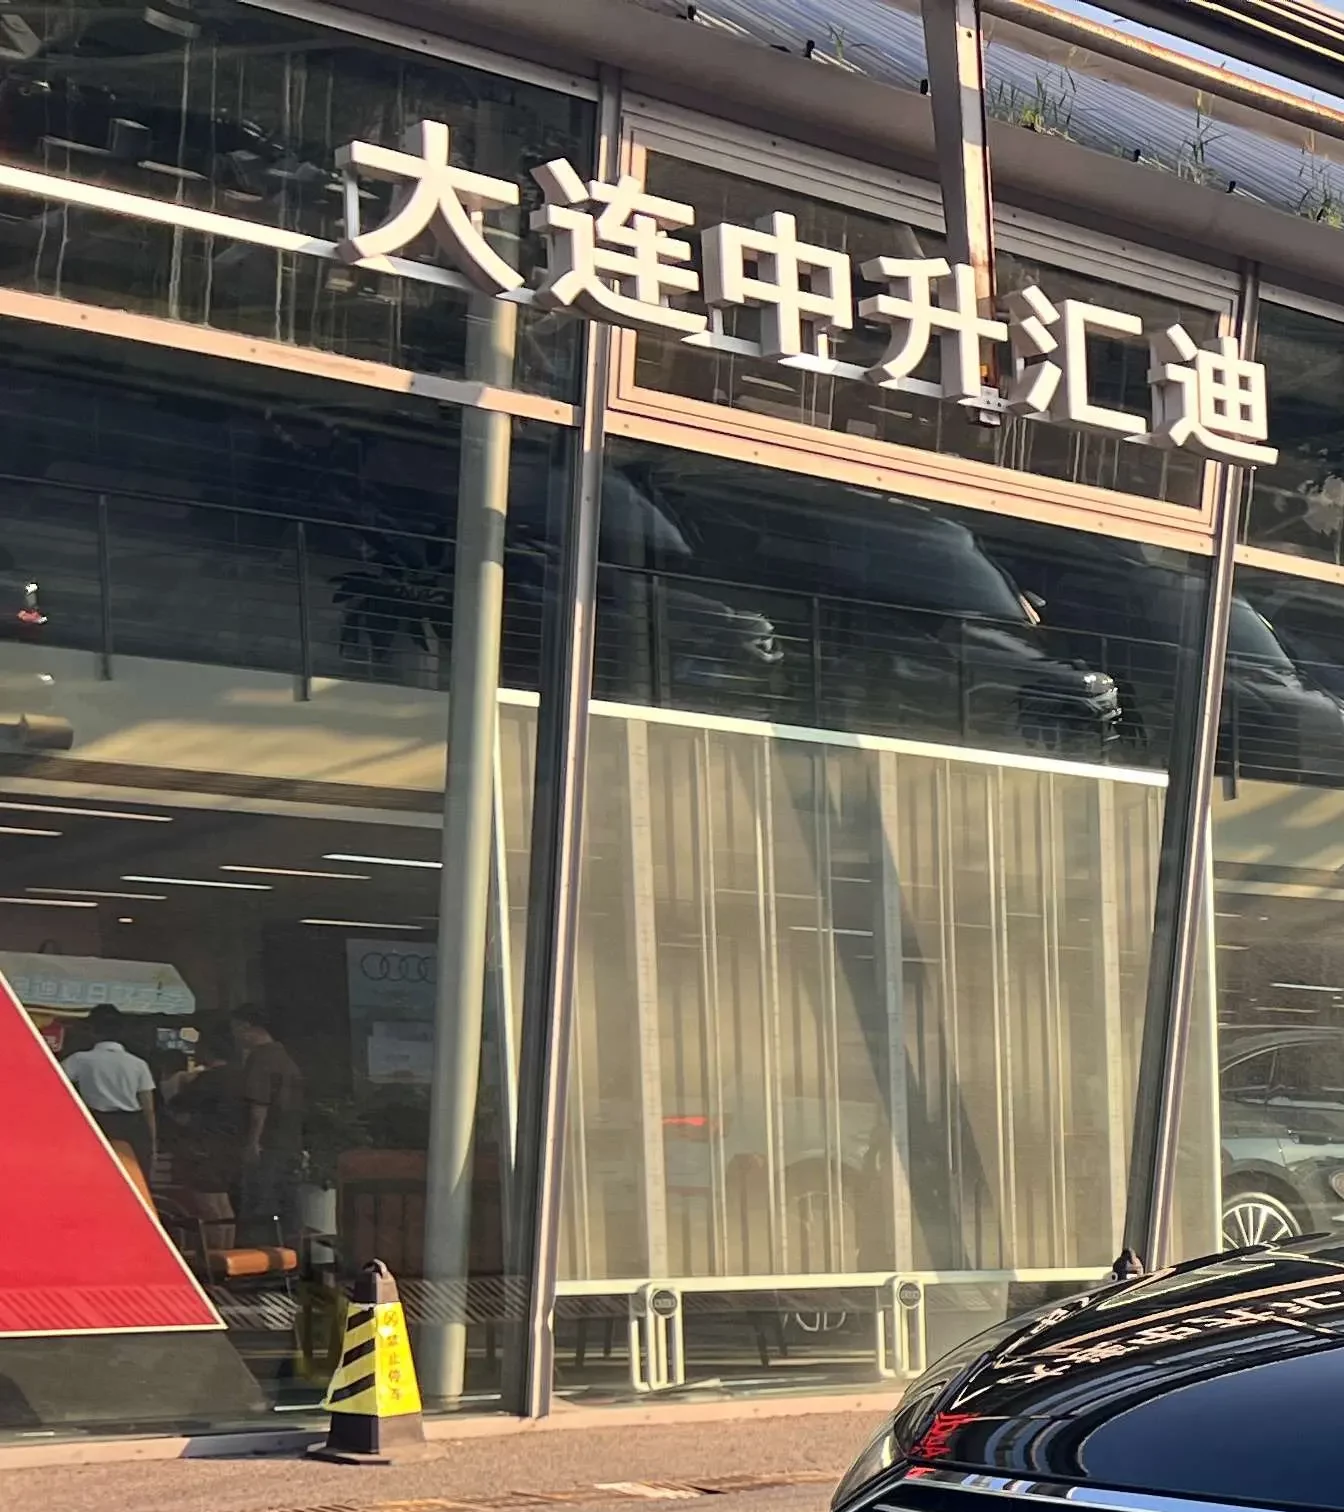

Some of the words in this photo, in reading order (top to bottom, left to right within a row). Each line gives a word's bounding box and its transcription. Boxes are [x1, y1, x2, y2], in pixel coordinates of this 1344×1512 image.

[334, 118, 1279, 465] 大连中升汇迪
